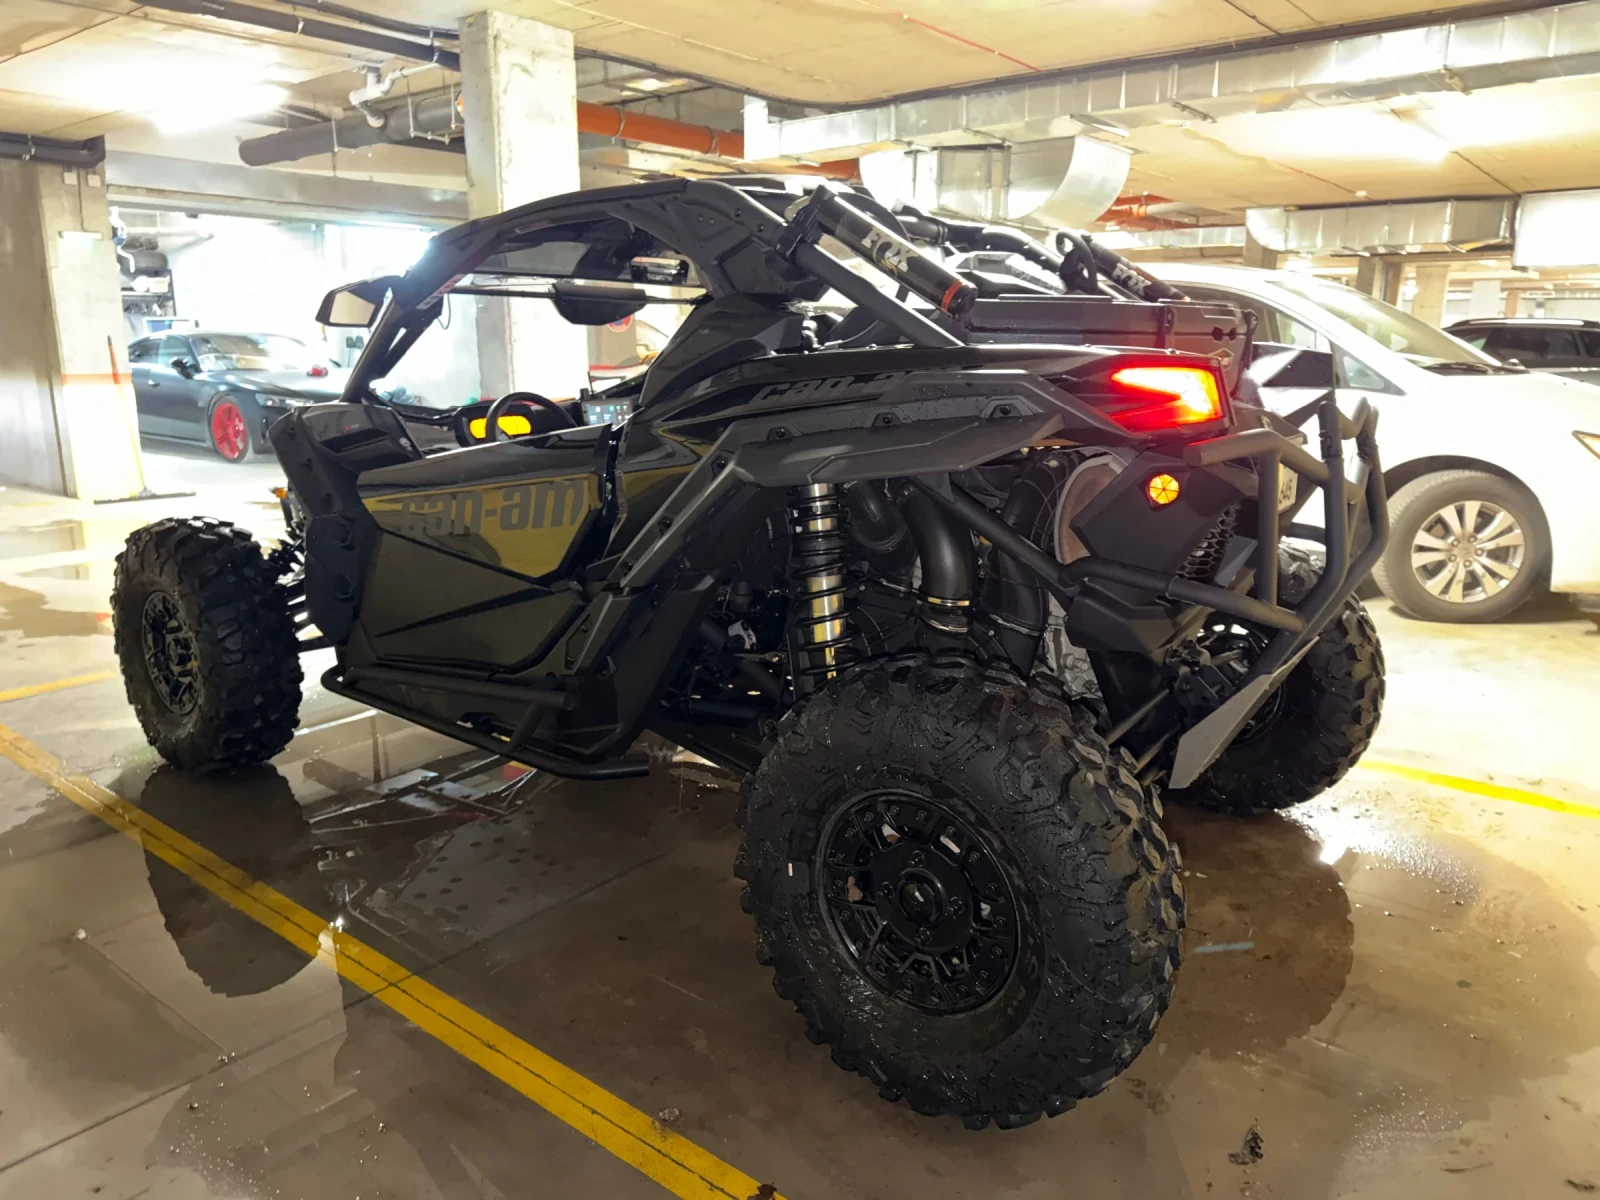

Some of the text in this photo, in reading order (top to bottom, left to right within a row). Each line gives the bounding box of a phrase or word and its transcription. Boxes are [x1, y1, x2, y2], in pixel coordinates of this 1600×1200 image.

[860, 226, 919, 273] FOX
[1112, 262, 1153, 297] FOX
[399, 478, 586, 537] can-am
